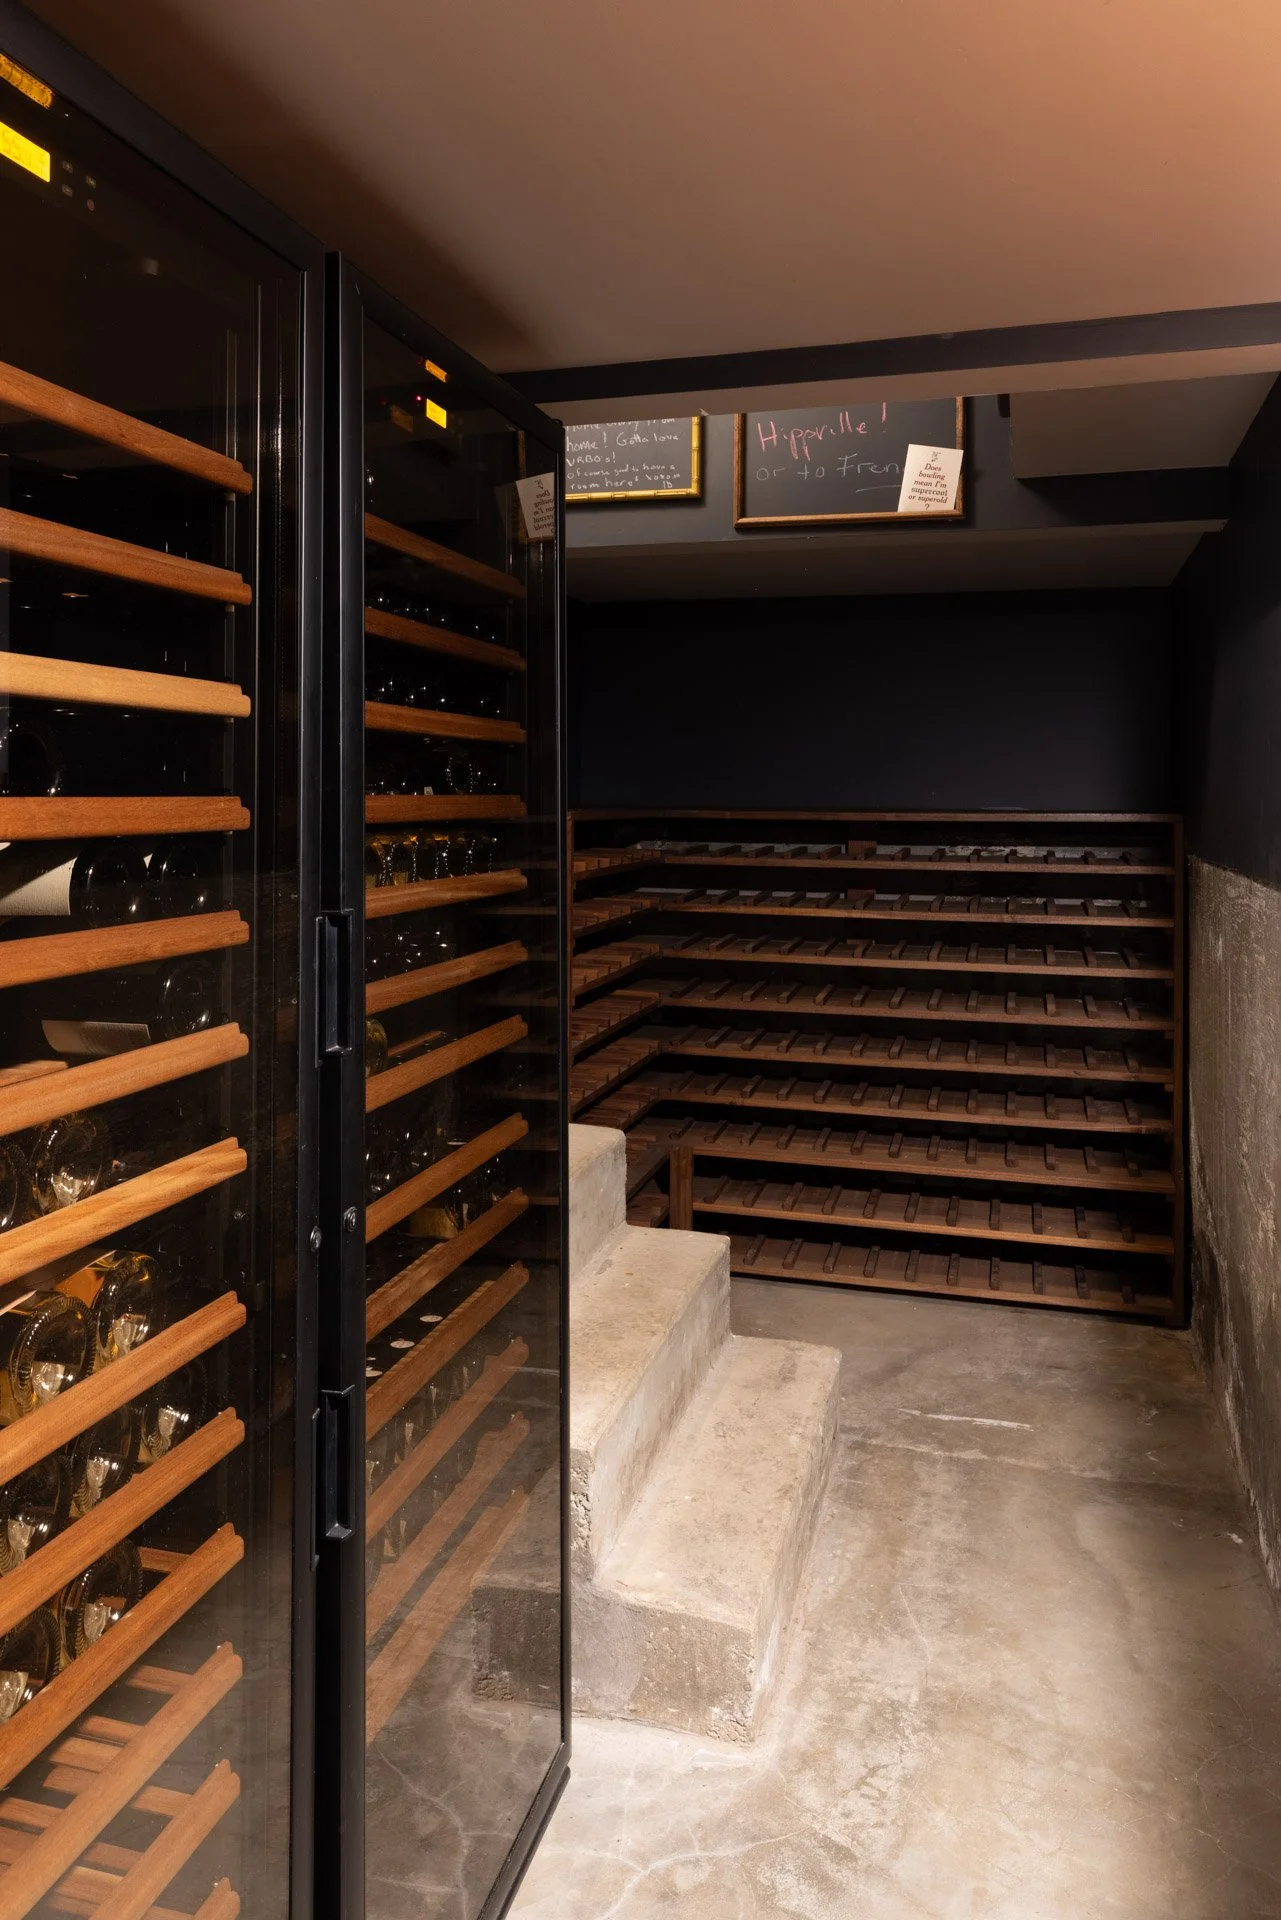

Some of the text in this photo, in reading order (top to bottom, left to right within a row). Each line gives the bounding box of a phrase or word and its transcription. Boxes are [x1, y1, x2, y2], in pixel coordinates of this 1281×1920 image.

[616, 431, 649, 446] Gotta
[653, 432, 679, 442] love
[756, 466, 785, 481] or
[797, 463, 825, 481] to
[924, 463, 942, 472] Does
[918, 470, 946, 481] bowling
[934, 481, 947, 489] I'm
[911, 487, 948, 496] supercool
[917, 496, 948, 504] superold
